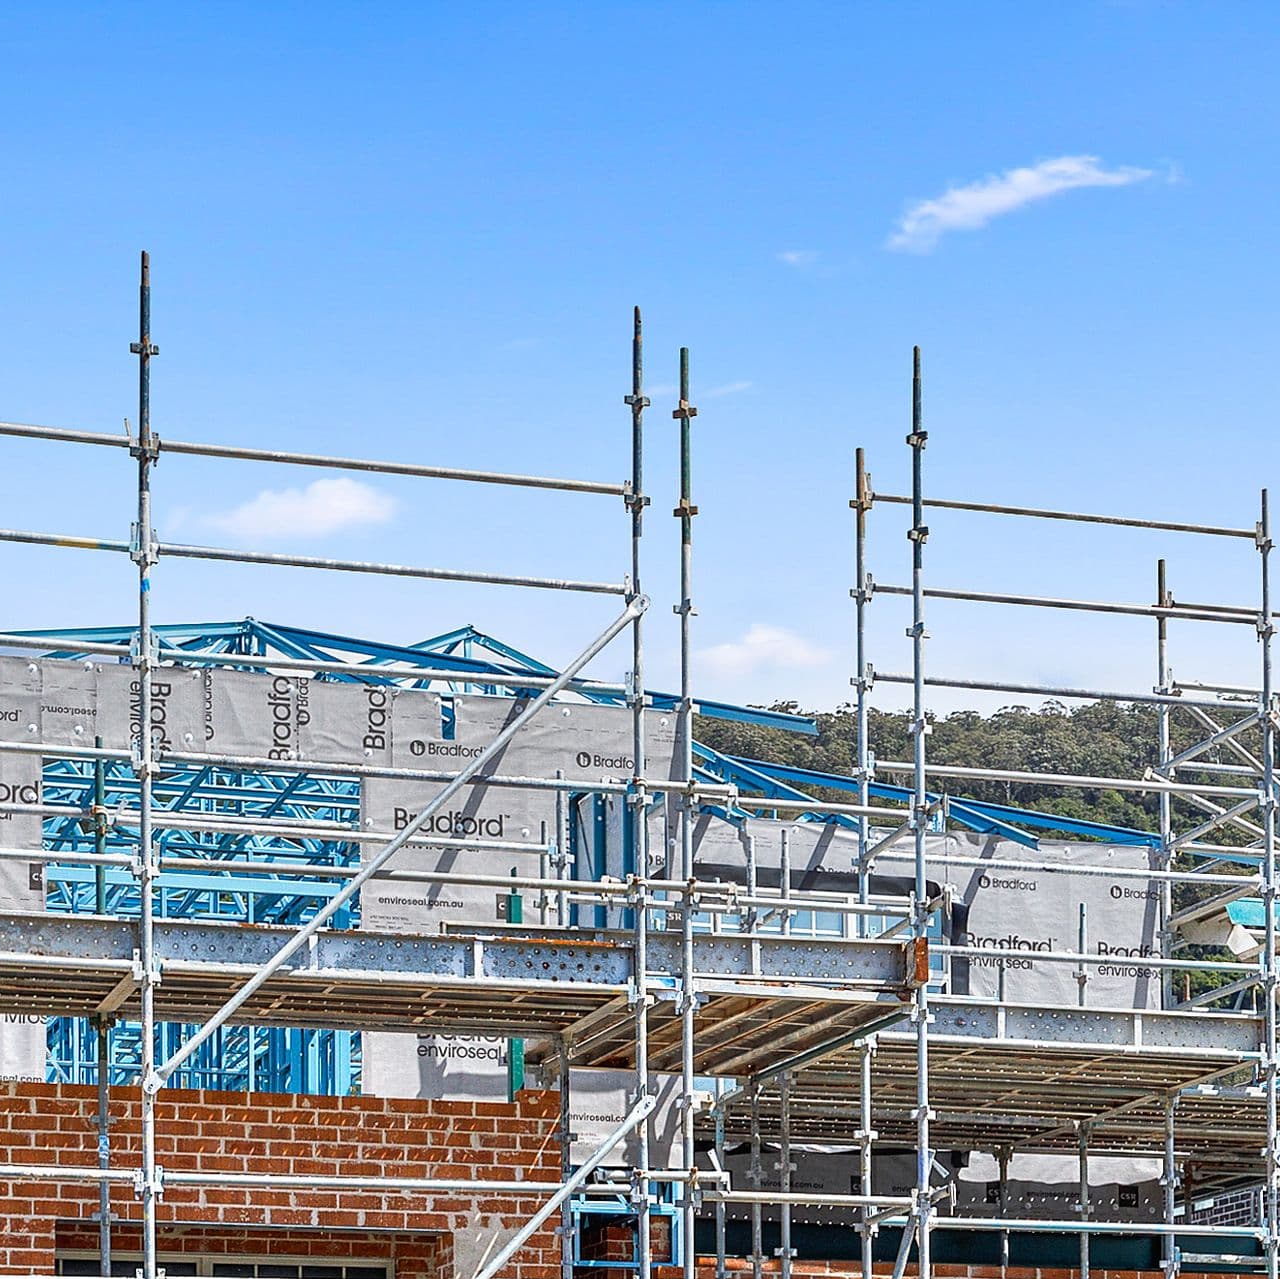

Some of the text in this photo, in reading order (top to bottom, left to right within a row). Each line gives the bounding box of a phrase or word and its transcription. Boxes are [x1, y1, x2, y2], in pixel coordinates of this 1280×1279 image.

[992, 878, 1037, 891] Bradford
[377, 896, 464, 909] enviroseal.com.au
[416, 1045, 501, 1060] enviroseal
